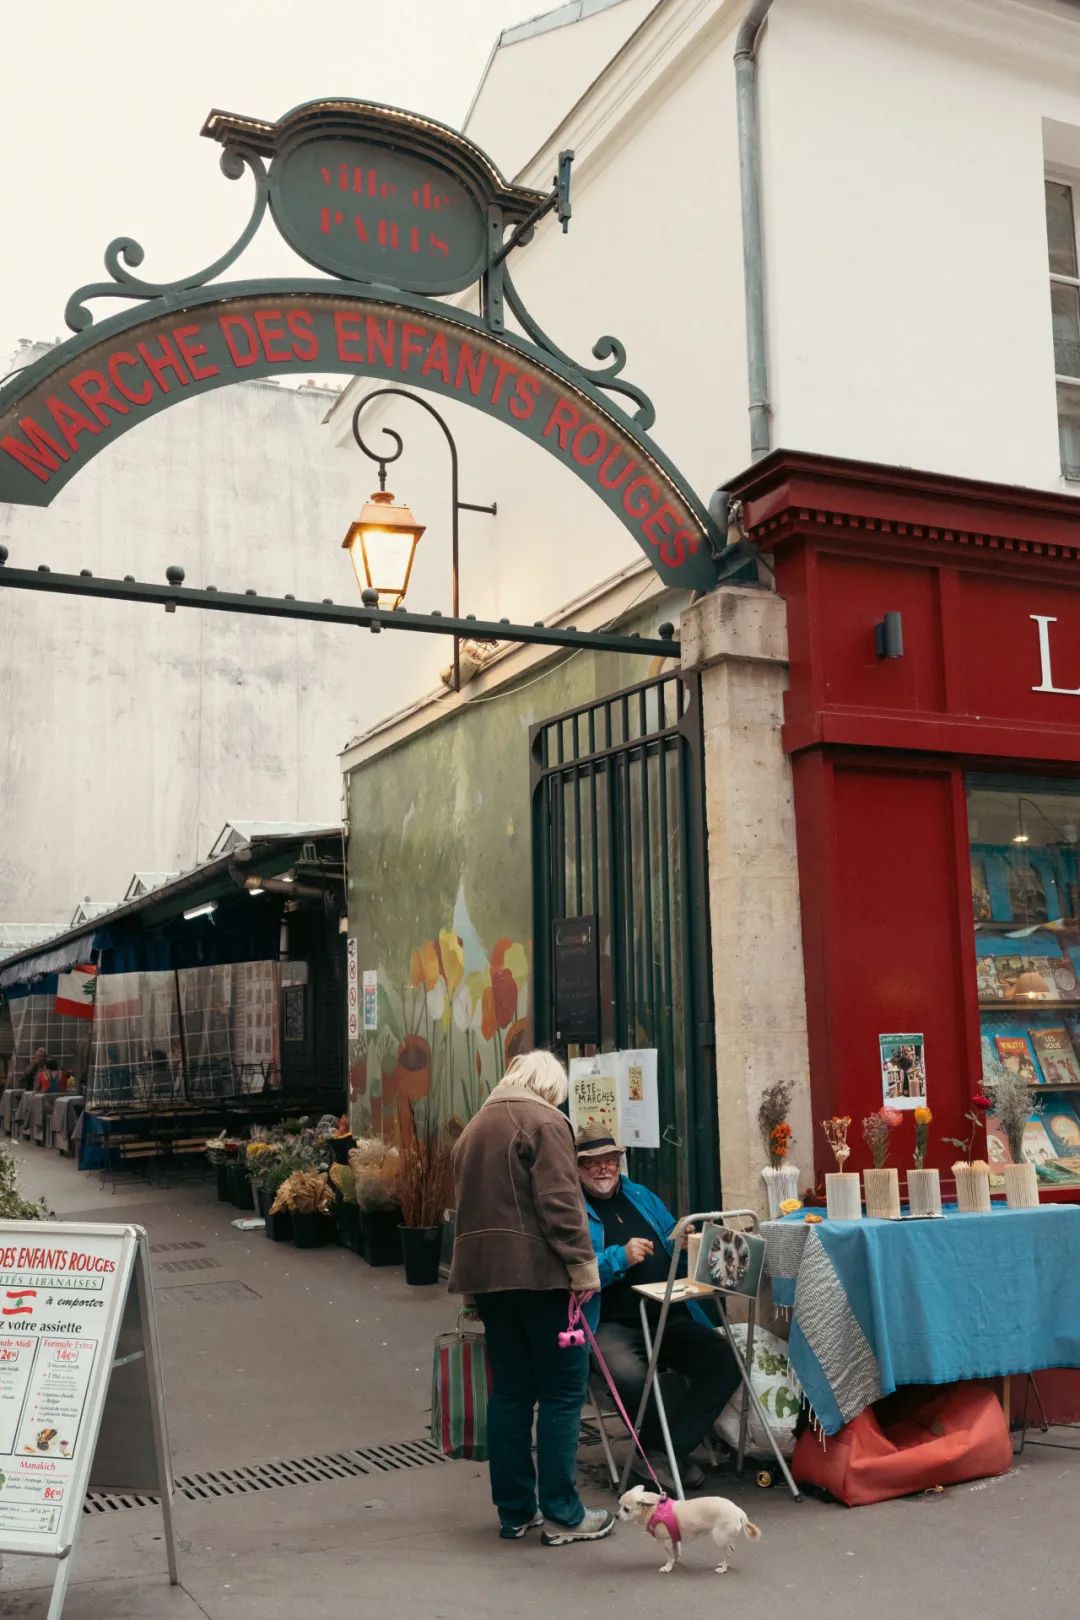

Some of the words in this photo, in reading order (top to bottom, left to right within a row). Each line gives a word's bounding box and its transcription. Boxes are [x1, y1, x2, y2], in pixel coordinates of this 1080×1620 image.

[319, 163, 398, 199] ville
[411, 183, 451, 209] de
[319, 207, 451, 257] PARIS
[0, 325, 220, 483] MARCHE
[218, 309, 319, 370] DES
[333, 311, 541, 421] ENFANTS
[543, 396, 699, 570] ROUGES
[17, 1247, 69, 1271] ENFANTS
[69, 1251, 116, 1273] ROUGES
[29, 1276, 98, 1288] LIBANAISES
[57, 1297, 104, 1309] emporter
[8, 1320, 37, 1331] votre
[39, 1320, 82, 1333] assiette
[43, 1340, 74, 1349] Formule
